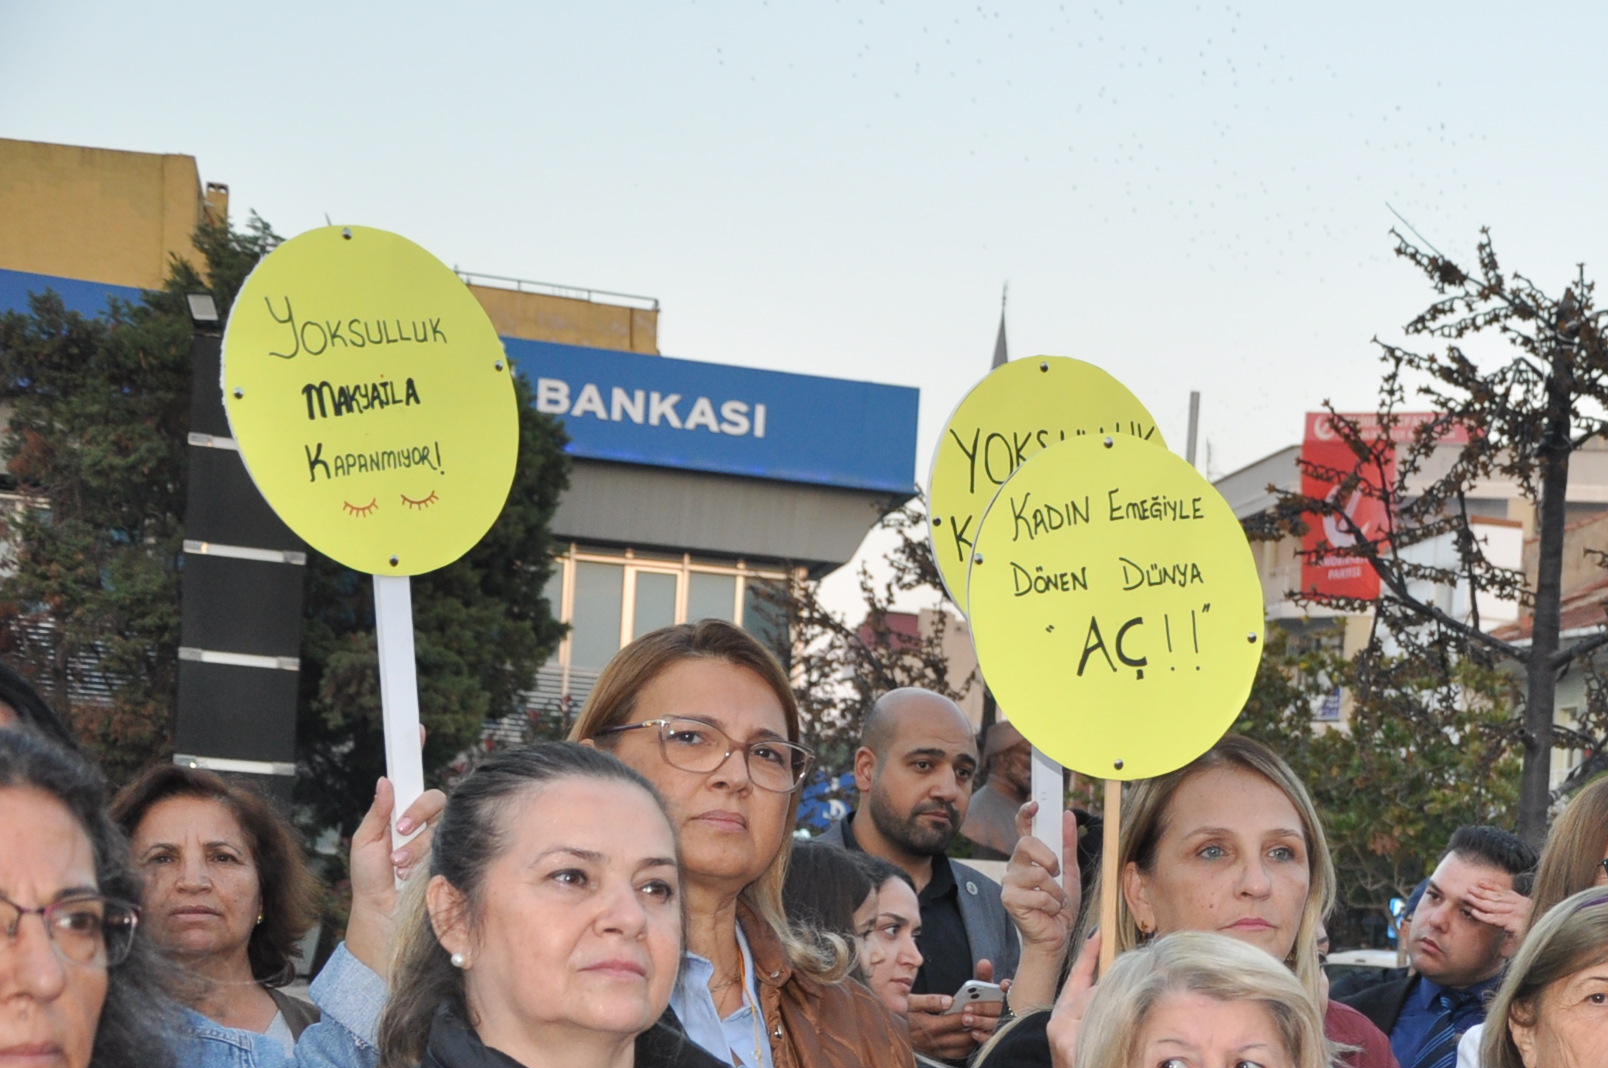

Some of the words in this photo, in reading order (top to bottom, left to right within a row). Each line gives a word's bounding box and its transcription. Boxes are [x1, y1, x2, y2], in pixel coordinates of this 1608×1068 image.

[265, 296, 447, 359] YOKSULLUK
[536, 377, 767, 438] BANKASI
[305, 441, 445, 482] KAPANMIYOR!
[1010, 492, 1089, 541] KADIN
[1010, 562, 1088, 597] DÖNEN
[1119, 557, 1204, 591] DÜNYA
